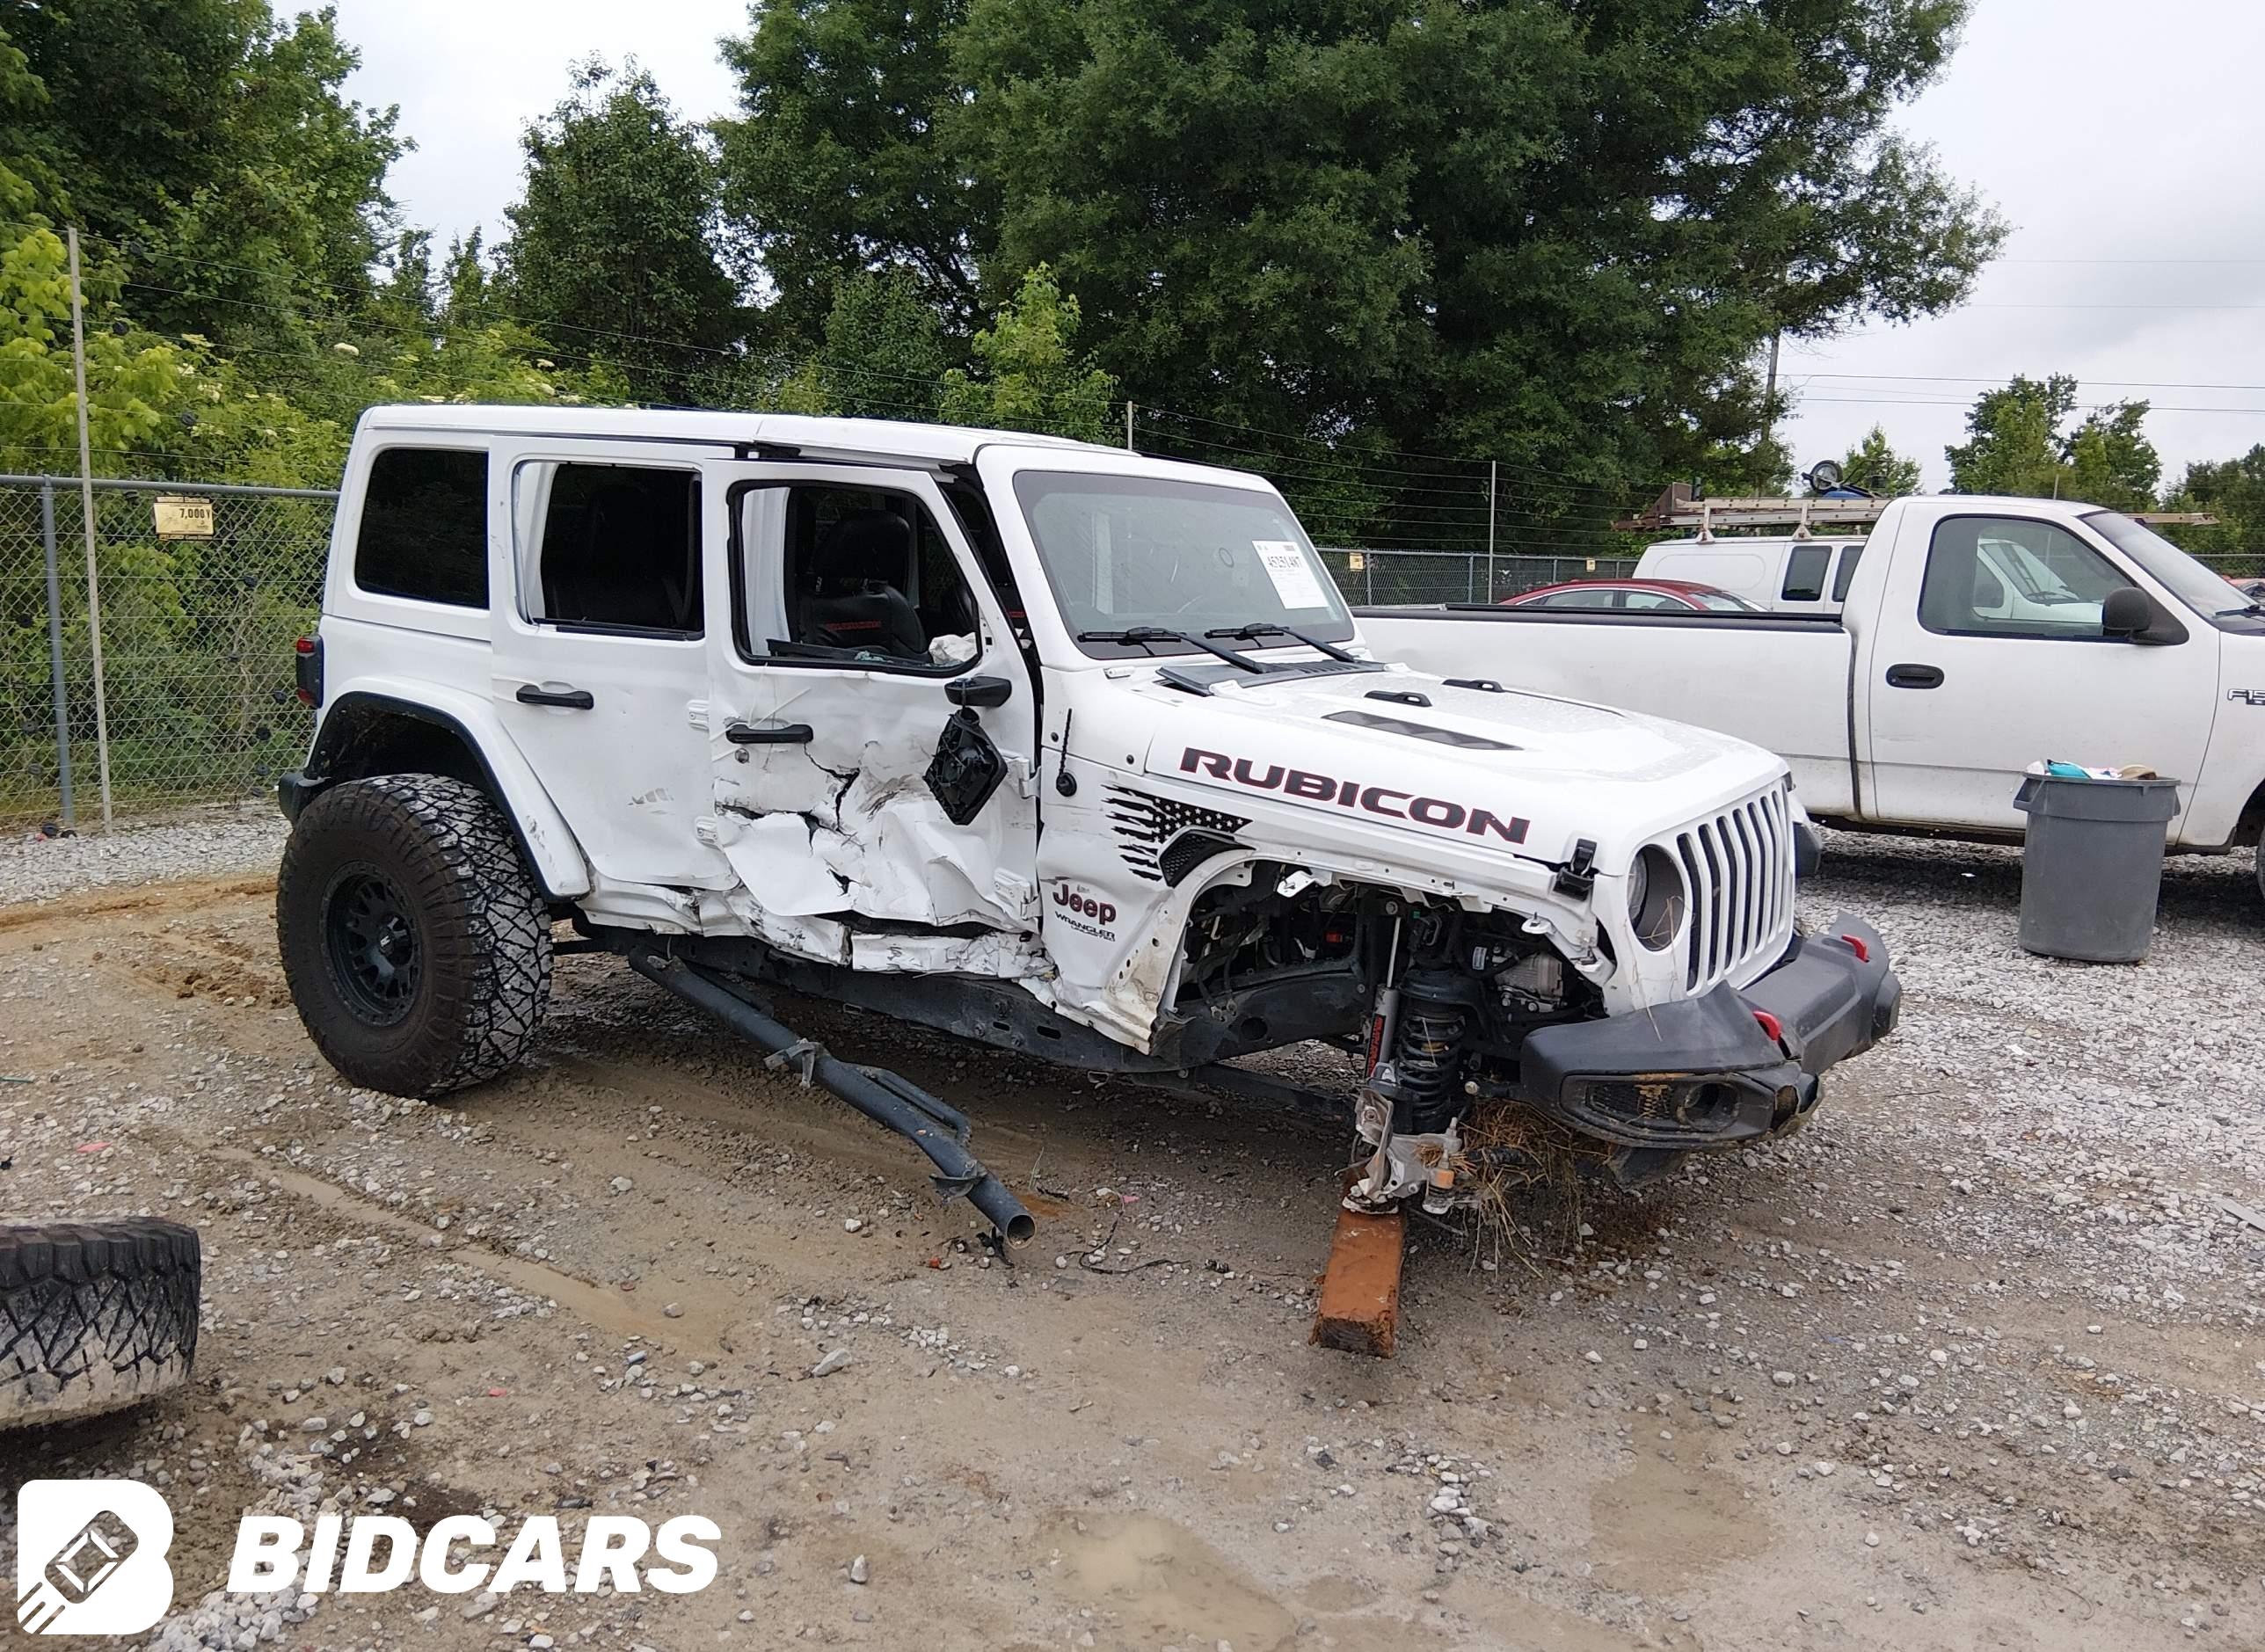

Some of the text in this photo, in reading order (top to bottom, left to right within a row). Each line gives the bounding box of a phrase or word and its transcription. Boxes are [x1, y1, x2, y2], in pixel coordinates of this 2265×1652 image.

[179, 508, 205, 519] 7,000
[1180, 747, 1530, 844] RUBICON
[1052, 884, 1116, 926] Jeep
[1055, 911, 1115, 938] WRANGLER
